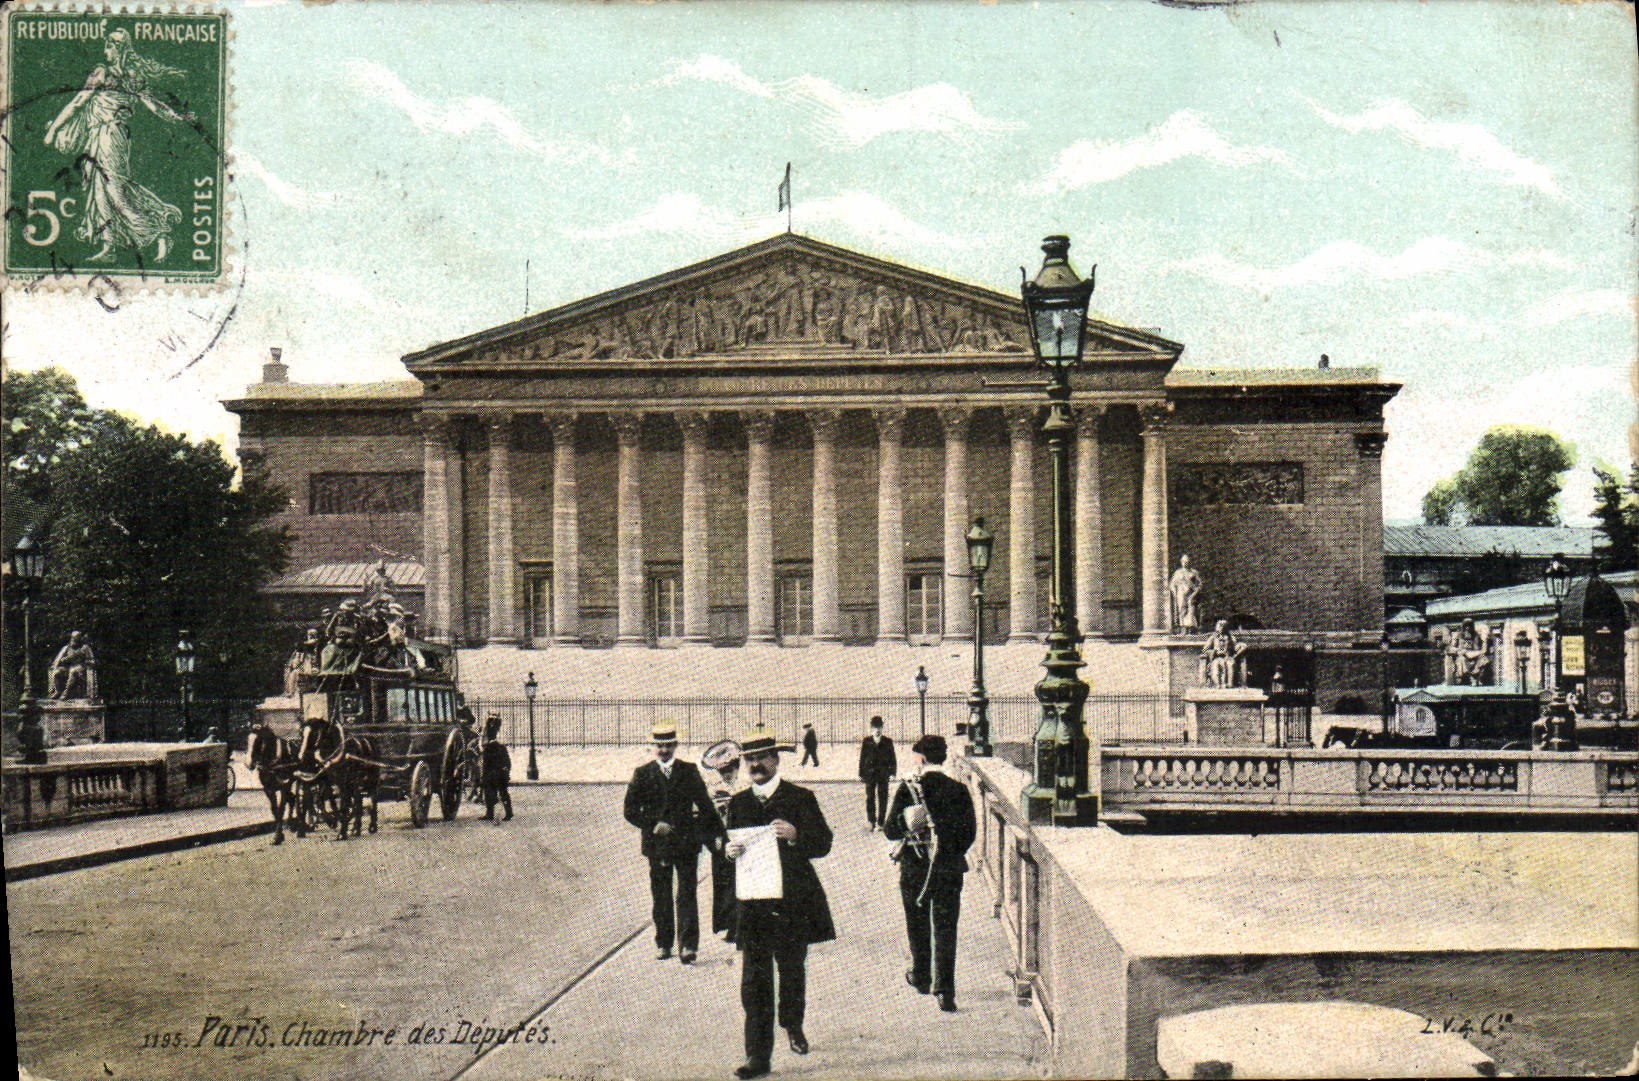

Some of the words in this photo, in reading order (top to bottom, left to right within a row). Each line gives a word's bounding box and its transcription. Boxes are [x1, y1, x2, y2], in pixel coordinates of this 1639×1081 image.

[17, 20, 107, 42] REPUBLIQUE
[135, 22, 217, 44] FRANÇAISE
[192, 176, 214, 261] POSTES
